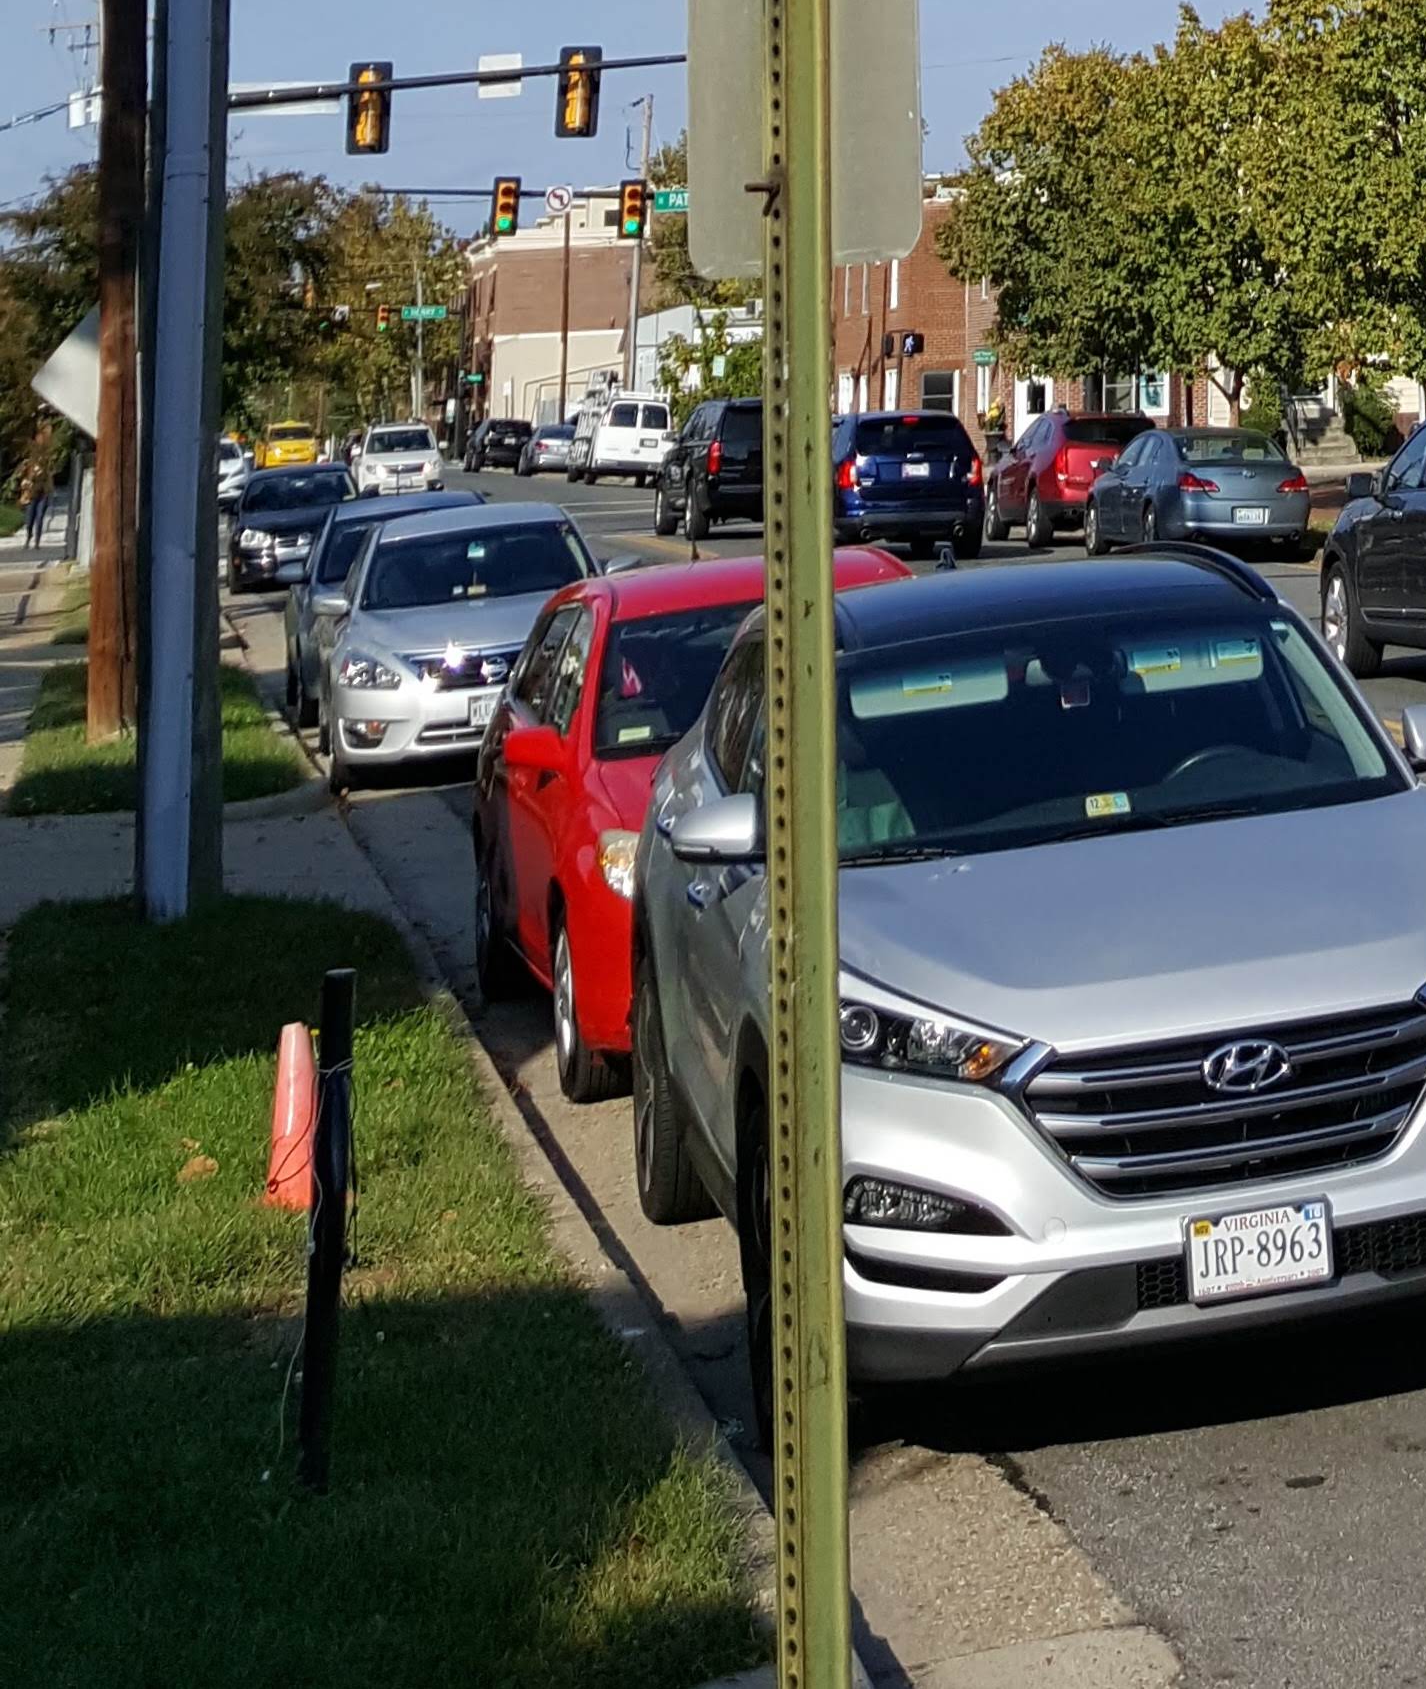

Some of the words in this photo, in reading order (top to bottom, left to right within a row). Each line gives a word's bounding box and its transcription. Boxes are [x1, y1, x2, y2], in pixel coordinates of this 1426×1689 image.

[669, 193, 689, 207] PAT
[1224, 1209, 1291, 1232] VIRGINIA
[1200, 1222, 1322, 1279] JRP-8963
